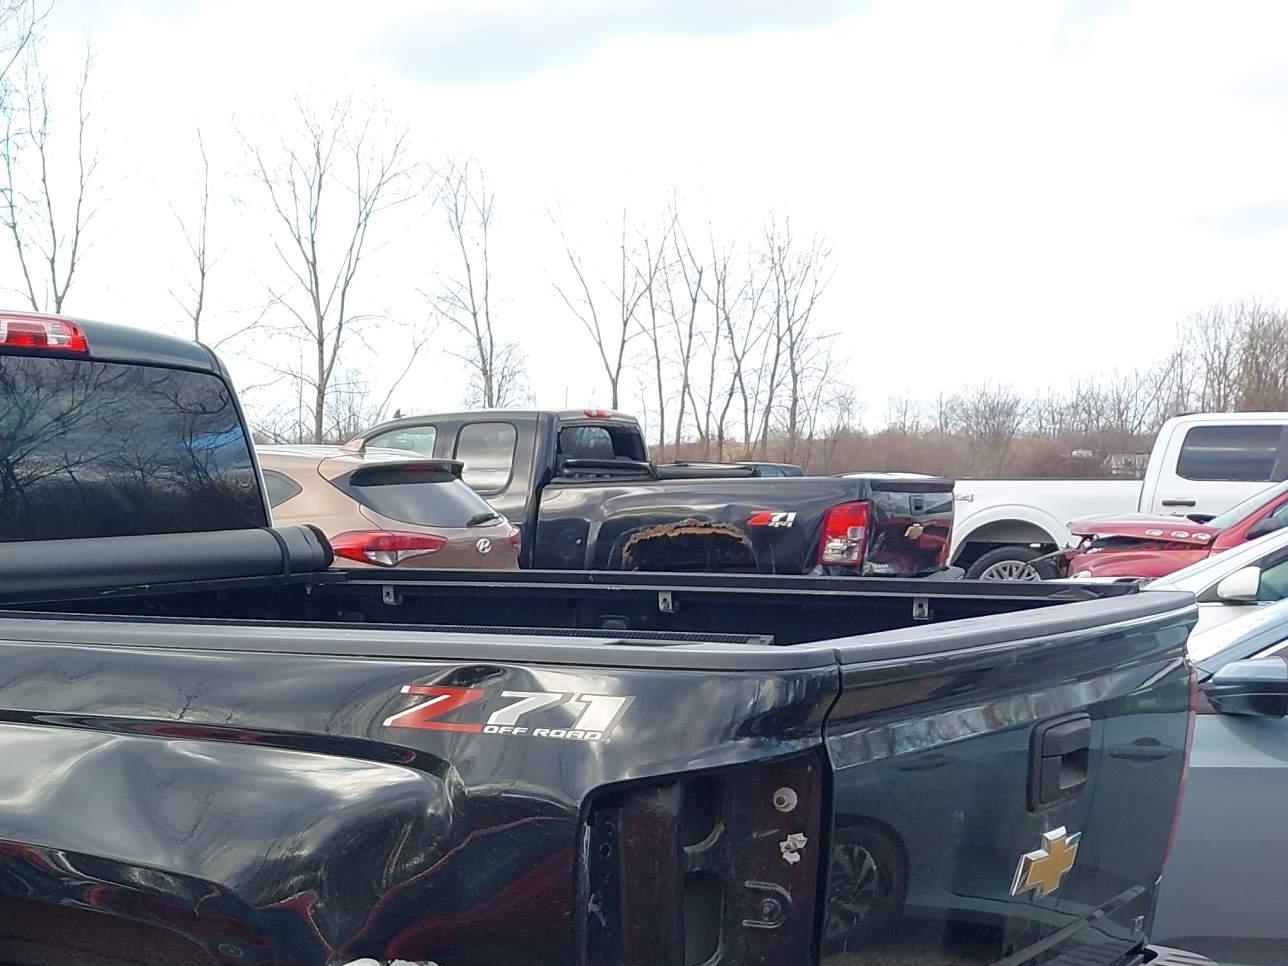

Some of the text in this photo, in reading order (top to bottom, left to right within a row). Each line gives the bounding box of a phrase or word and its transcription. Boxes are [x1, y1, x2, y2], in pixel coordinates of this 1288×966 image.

[382, 684, 634, 734] Z71
[482, 725, 605, 741] OFF ROAD
